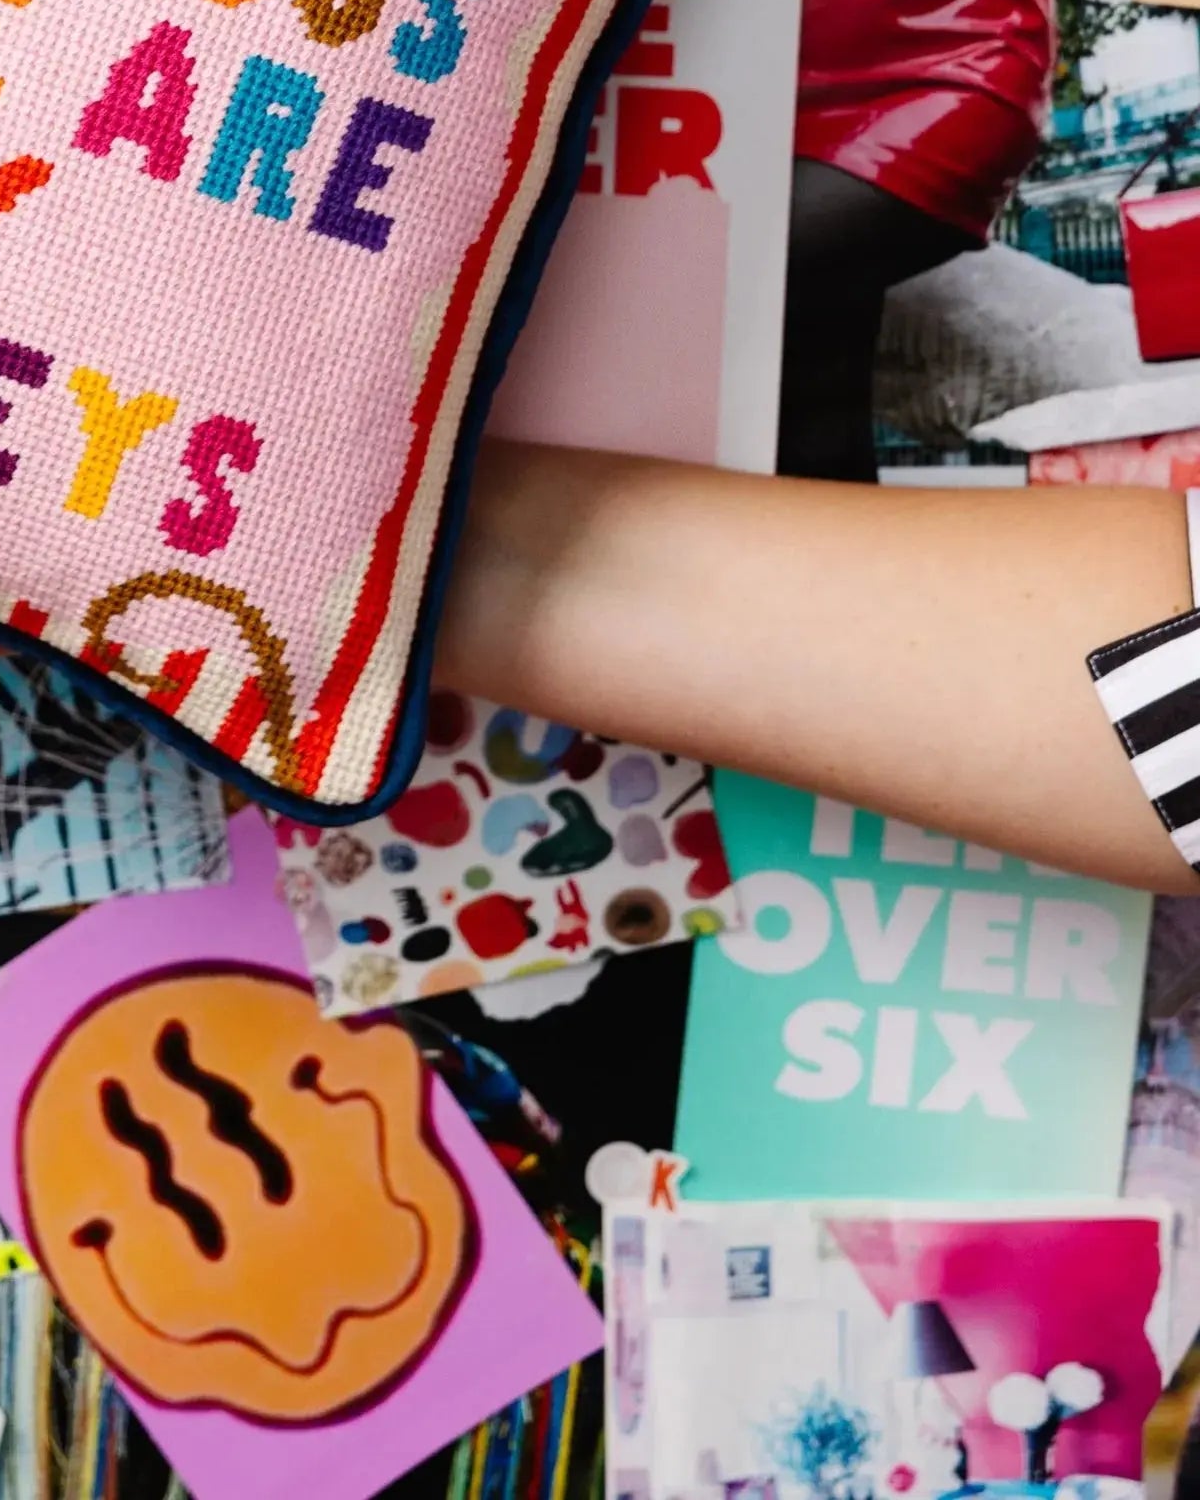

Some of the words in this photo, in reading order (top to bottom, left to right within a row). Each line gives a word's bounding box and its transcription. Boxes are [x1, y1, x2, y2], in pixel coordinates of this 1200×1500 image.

[70, 20, 436, 253] ARE
[713, 869, 1122, 1007] OVER
[773, 998, 1035, 1120] SIX
